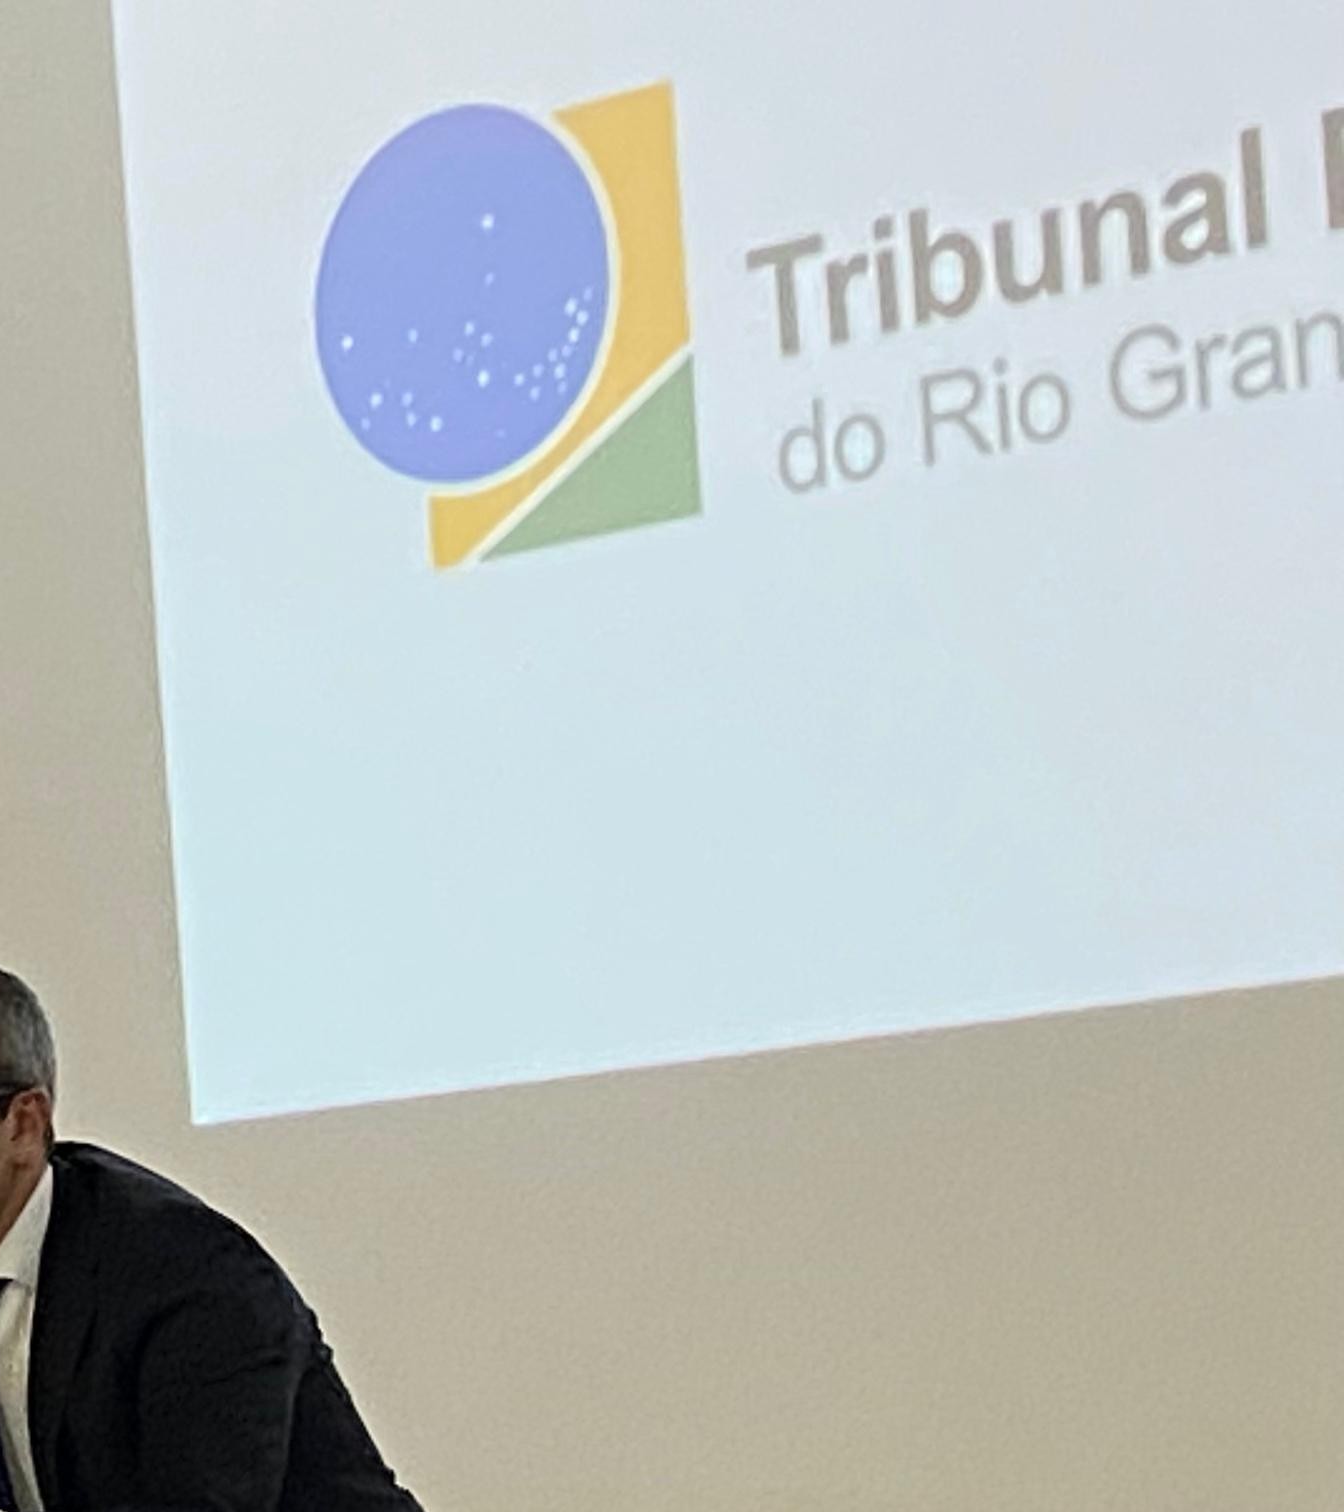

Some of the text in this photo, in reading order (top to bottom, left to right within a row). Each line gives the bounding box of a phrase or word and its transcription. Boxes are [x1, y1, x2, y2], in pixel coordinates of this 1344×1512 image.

[745, 125, 1269, 359] Tribunal
[778, 398, 886, 493] do
[918, 356, 1071, 468] Rio
